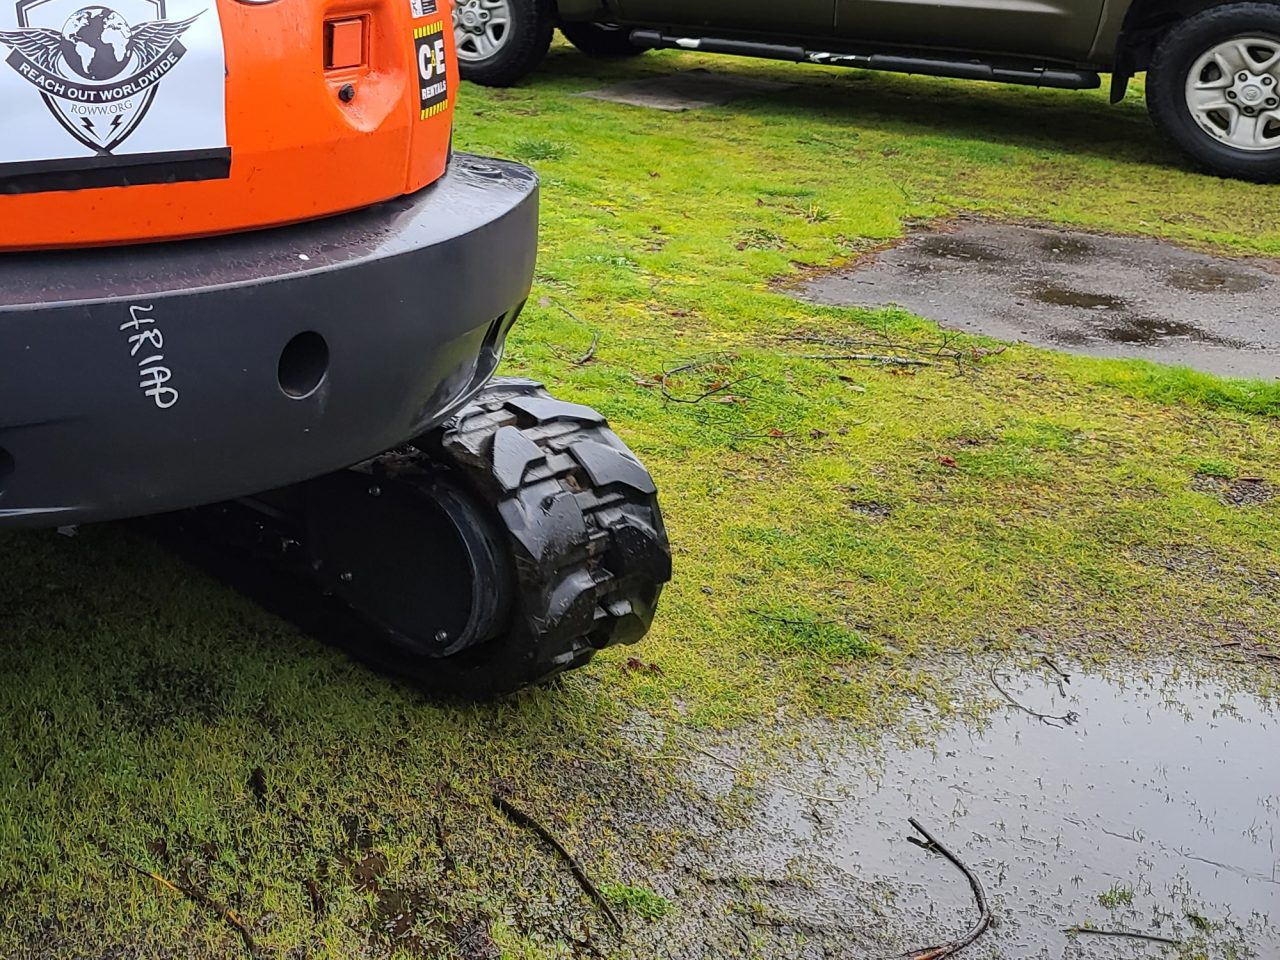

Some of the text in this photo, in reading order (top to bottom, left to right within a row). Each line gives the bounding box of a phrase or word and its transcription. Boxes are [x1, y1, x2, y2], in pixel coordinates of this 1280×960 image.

[418, 39, 446, 80] C&E
[19, 52, 178, 102] REACH OUT WORLDWIDE
[421, 80, 447, 100] RENTALS
[70, 100, 133, 116] ROWW.ORG
